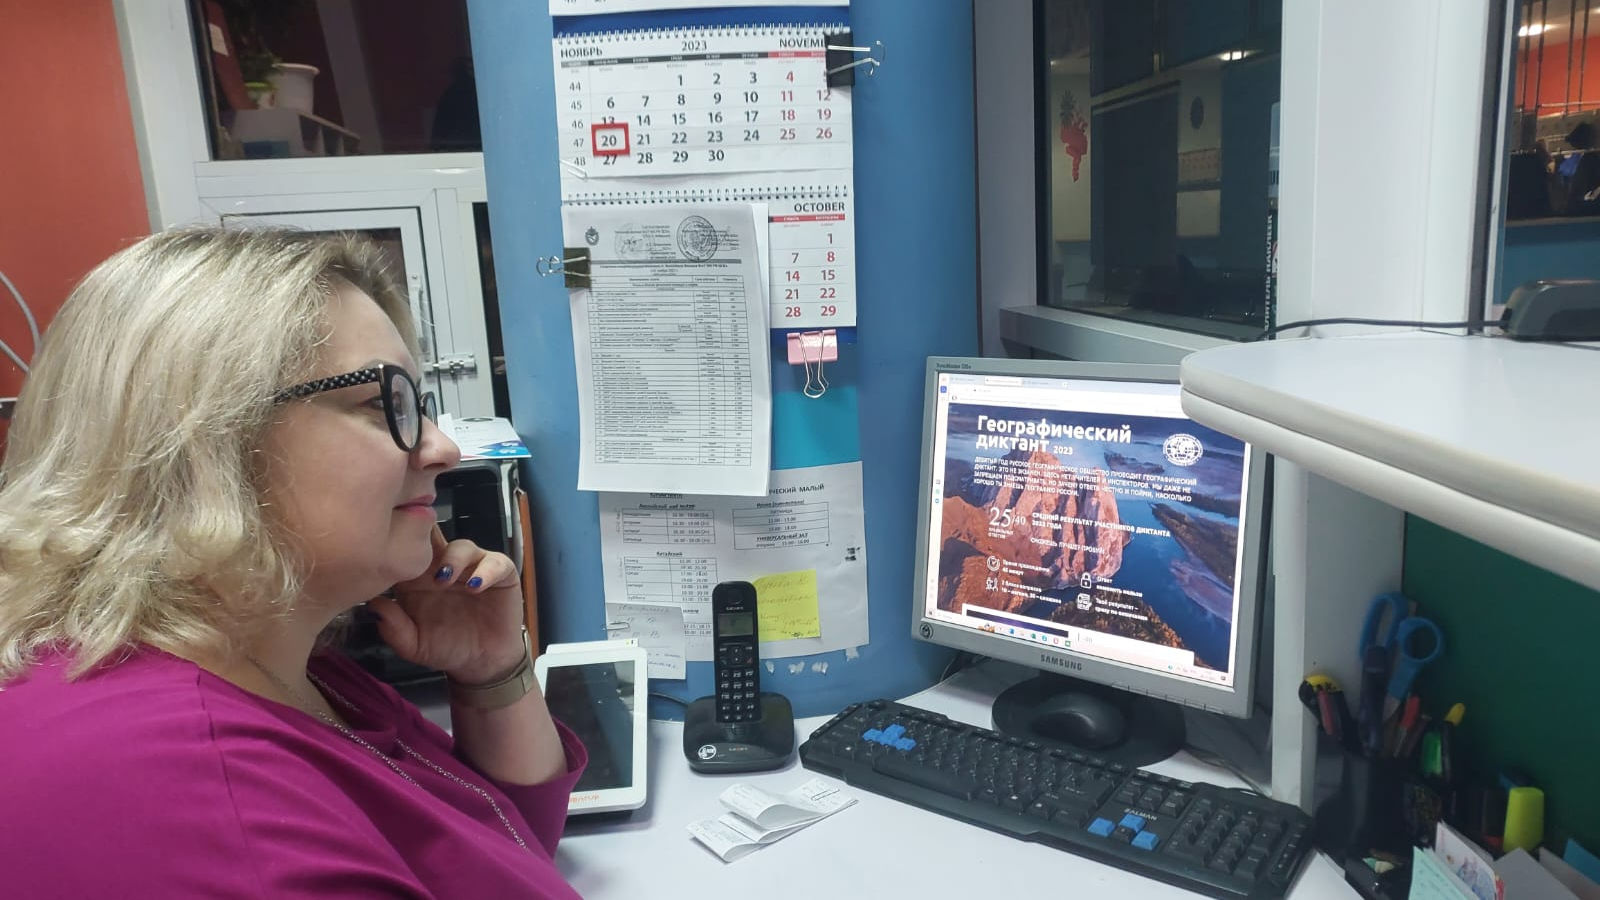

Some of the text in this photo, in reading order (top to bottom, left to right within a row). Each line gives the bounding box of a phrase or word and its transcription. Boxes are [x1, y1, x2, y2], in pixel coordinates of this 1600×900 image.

[681, 40, 707, 52] 2023
[780, 38, 826, 48] NOVEM
[560, 46, 602, 58] НОЯБРЬ
[569, 71, 794, 91] 44 1 2 3 4
[571, 89, 831, 110] 45 6 7 8 9 10 11 12
[572, 120, 584, 129] 46
[637, 114, 651, 126] 14
[672, 113, 686, 125] 15
[708, 111, 723, 123] 16
[745, 110, 759, 122] 17
[781, 109, 796, 121] 18
[817, 109, 832, 120] 19
[573, 128, 832, 147] 47 20 21 22 23 24 25 26
[603, 155, 617, 165] 27
[637, 152, 653, 164] 28
[672, 151, 688, 163] 29
[708, 149, 724, 161] 30
[794, 202, 845, 213] OCTOBER
[827, 233, 833, 244] 1
[792, 251, 835, 263] 7 8
[786, 270, 835, 282] 14 15
[785, 288, 836, 300] 21 22
[785, 306, 836, 317] 28 29
[977, 415, 1132, 444] Географический
[975, 434, 1073, 455] диктант 2023
[799, 483, 824, 492] МАЛЫЙ
[1136, 527, 1170, 537] ДИКТАНТА
[1040, 654, 1083, 671] SAMSUNG
